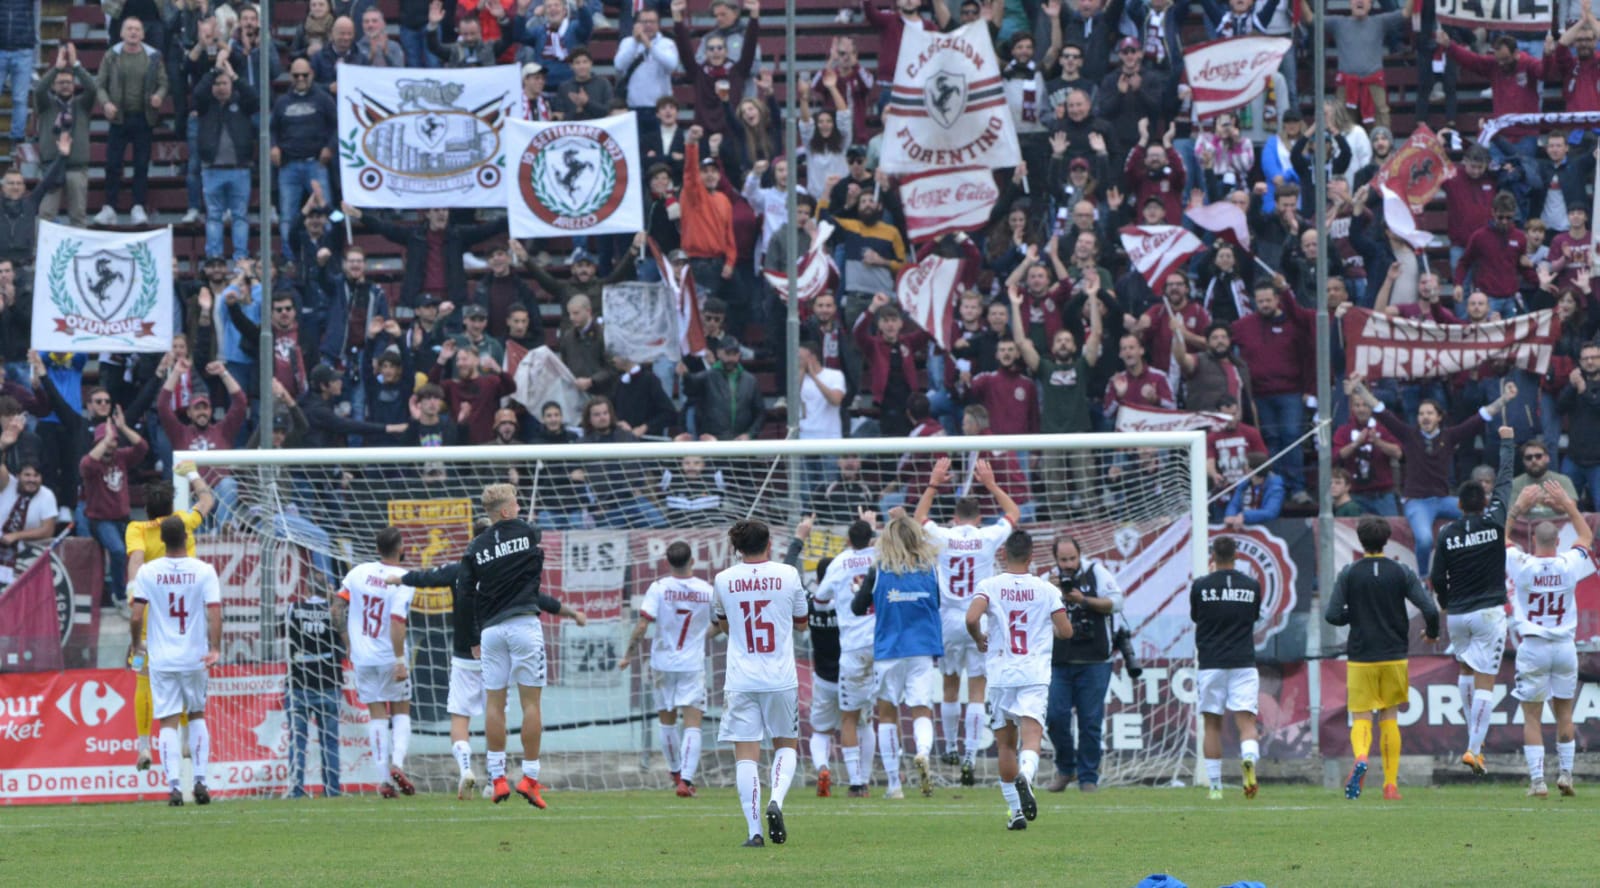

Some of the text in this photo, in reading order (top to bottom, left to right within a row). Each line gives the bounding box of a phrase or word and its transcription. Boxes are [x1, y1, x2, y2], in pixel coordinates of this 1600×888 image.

[533, 125, 601, 150] SETTEMBRE
[896, 116, 1004, 165] FIORENTINO
[553, 213, 598, 230] AREZZO
[66, 314, 142, 335] OVUNQUE
[948, 539, 983, 551] RUGGERI
[1446, 528, 1498, 550] S.S. AREZZO
[476, 536, 530, 565] S.S. AREZZO
[156, 573, 196, 585] PANATTI
[728, 577, 782, 593] LOMASTO
[949, 556, 975, 598] 21
[1533, 574, 1562, 587] MUZZI
[664, 590, 710, 604] STRAMBELLI
[1001, 588, 1034, 601] PISANU
[1201, 588, 1255, 603] S.S. AREZZO
[168, 592, 189, 635] 4
[362, 594, 385, 639] 19
[1527, 592, 1566, 626] 24
[676, 609, 692, 651] 7
[739, 600, 776, 654] 15
[1009, 610, 1028, 655] 6
[28, 770, 138, 791] Domenica
